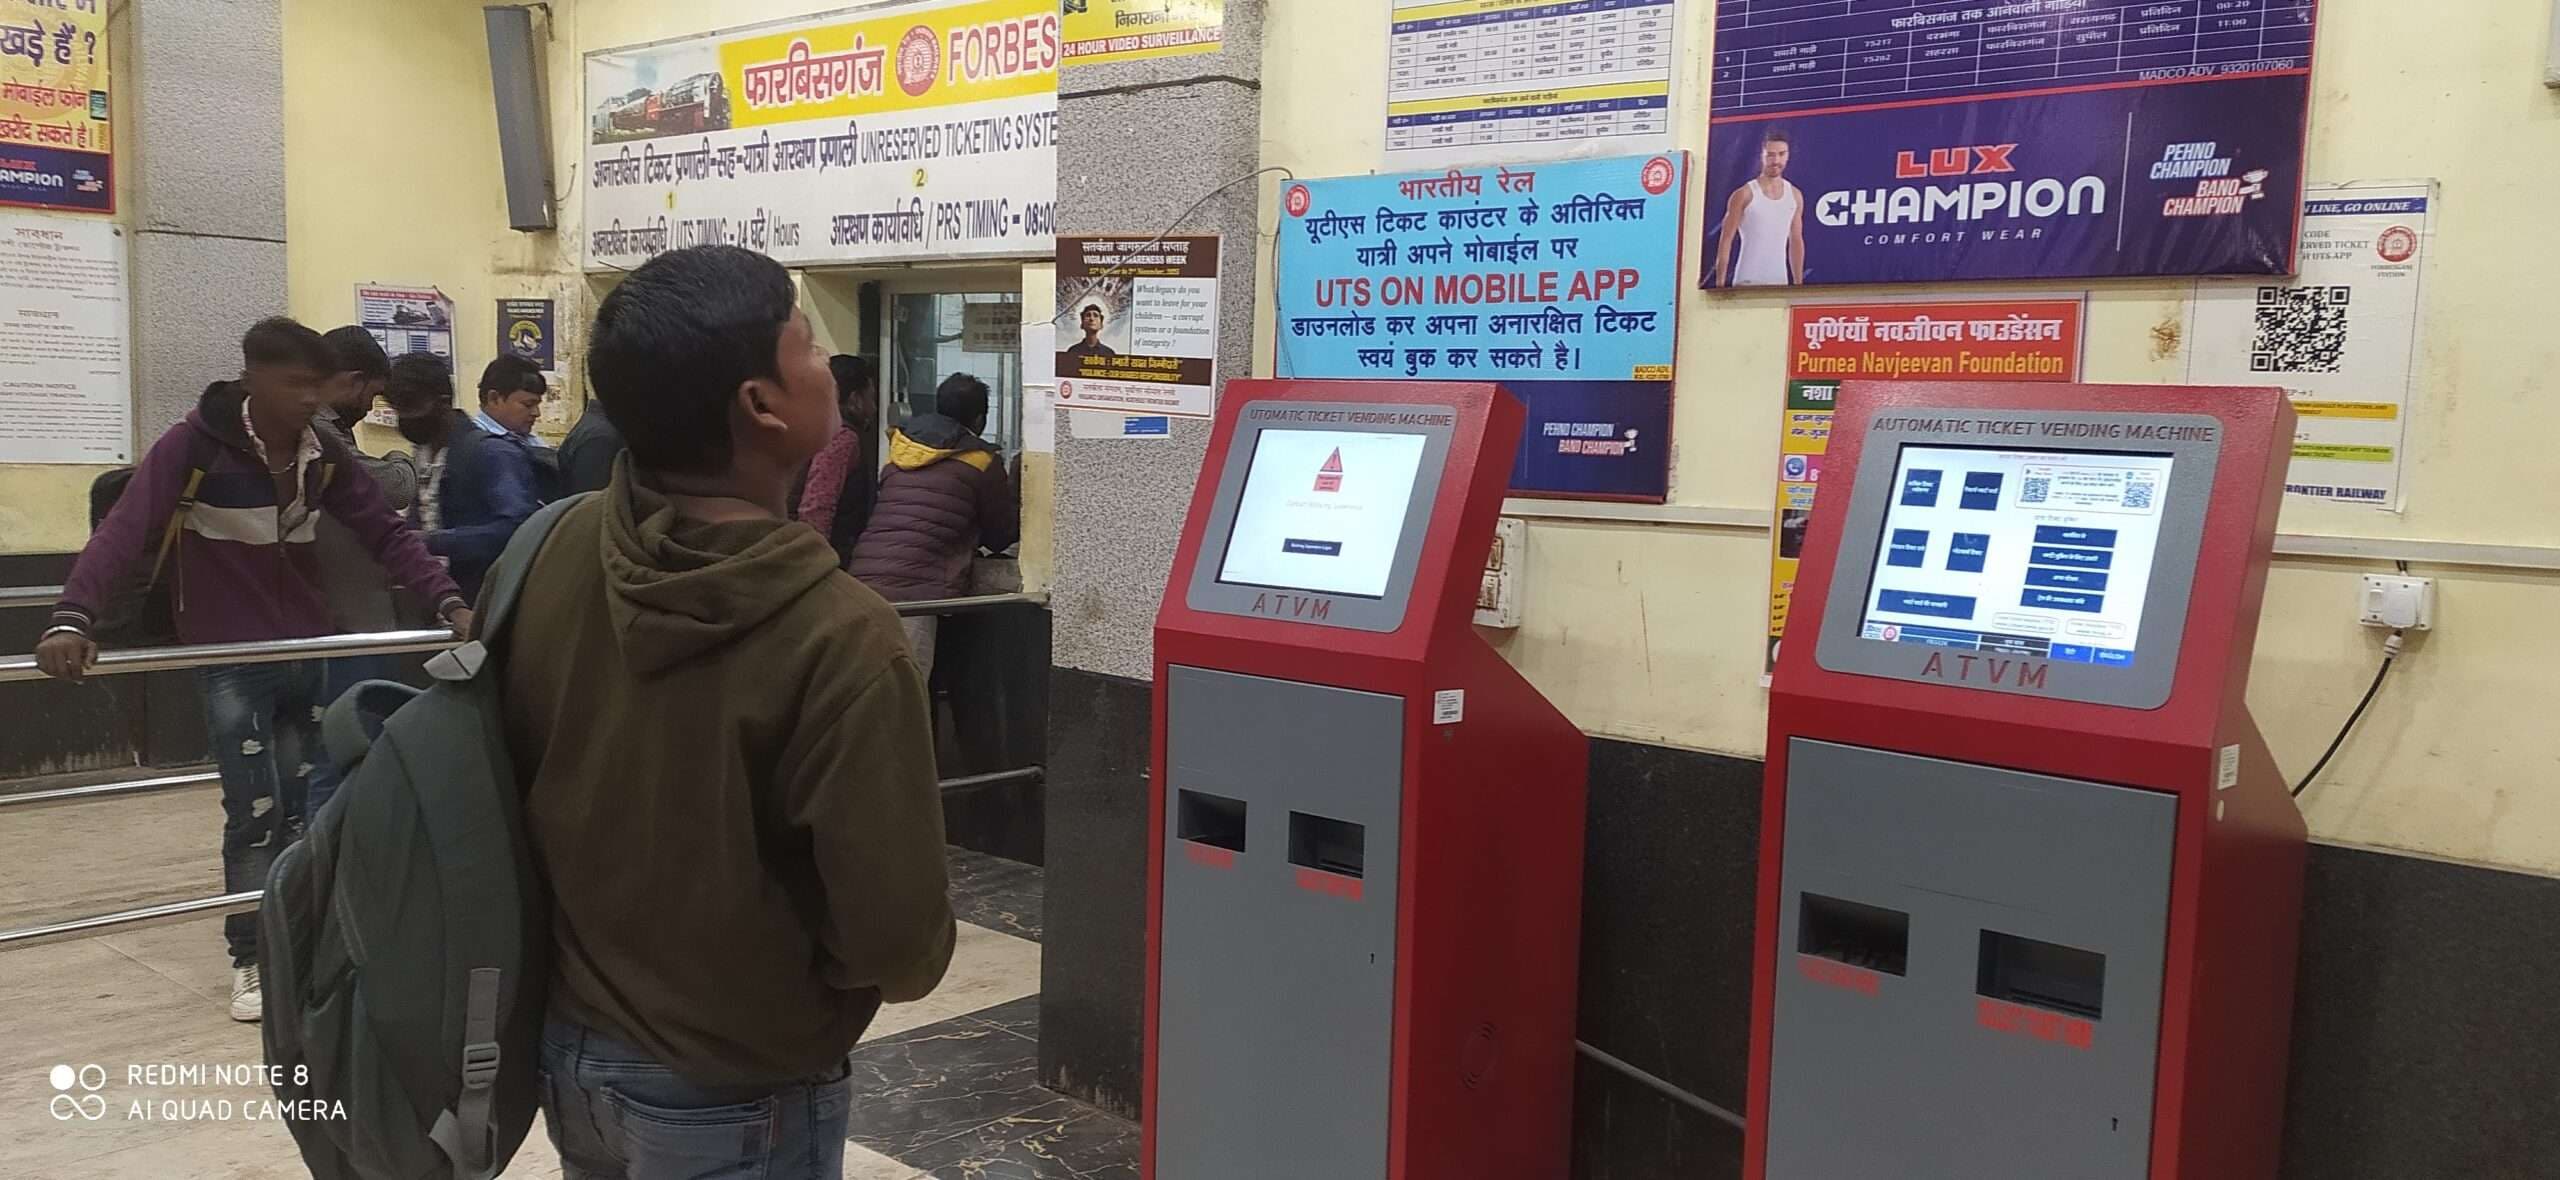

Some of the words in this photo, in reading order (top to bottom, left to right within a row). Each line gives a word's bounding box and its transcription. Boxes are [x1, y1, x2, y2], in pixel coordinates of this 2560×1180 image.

[1961, 9, 1984, 20] तक
[2140, 6, 2182, 18] प्रतिदिन
[2139, 23, 2181, 35] प्रतिदिन
[52, 22, 77, 65] हैं
[84, 31, 96, 65] ?
[949, 15, 1058, 82] FORBES
[1063, 43, 1076, 57] 24
[1077, 40, 1107, 55] HOUR
[1108, 36, 1140, 51] VIDEO
[1141, 28, 1221, 49] SURVEILLANCE
[744, 36, 885, 106] फारबिसगंज
[59, 84, 88, 111] फोन
[36, 120, 73, 145] सकते
[861, 124, 941, 164] UNRESERVED
[944, 116, 1011, 157] TICKETING
[592, 145, 641, 189] अनारक्षित
[643, 143, 674, 184] टिकट
[772, 138, 816, 173] आरक्षण
[819, 120, 858, 175] प्रणाली
[1895, 143, 2022, 180] LUX
[2163, 141, 2217, 162] PEHNO
[915, 168, 926, 188] 2
[2149, 157, 2231, 181] CHAMPION
[1399, 169, 1483, 200] भारतीय
[1498, 167, 1536, 194] रेल
[2196, 178, 2240, 198] BANO
[1815, 175, 2106, 227] CHAMPION
[2162, 194, 2246, 217] CHAMPION
[2310, 203, 2342, 213] LINE,
[2343, 202, 2363, 212] GO
[2363, 201, 2411, 211] ONLINE
[830, 214, 869, 246] आरक्षण
[935, 202, 961, 241] PRS
[965, 197, 1008, 239] TIMING
[1306, 209, 1366, 243] यूटीएस
[1376, 206, 1428, 234] टिकट
[1439, 200, 1508, 230] काउंटर
[1519, 198, 1539, 226] के
[1550, 191, 1647, 225] अतिरिक्त
[773, 215, 800, 247] Hours
[1863, 229, 1967, 246] COMFORT
[1981, 226, 2044, 242] WEAR
[2304, 230, 2331, 238] CODE
[1161, 241, 1191, 254] सप्ताह
[1357, 238, 1398, 268] यात्री
[1408, 235, 1453, 266] अपने
[1464, 233, 1539, 265] मोबाईल
[1551, 236, 1580, 259] पर
[2335, 240, 2370, 249] TICKET
[1082, 255, 1122, 265] VIGILANCE
[1122, 255, 1165, 265] AWARENESS
[1166, 255, 1188, 265] WEEK
[1136, 284, 1154, 293] What
[1178, 285, 1187, 294] do
[1187, 287, 1201, 296] you
[1315, 277, 1371, 308] UTS
[1380, 275, 1424, 305] ON
[1434, 270, 1559, 305] MOBILE
[1567, 268, 1641, 301] APP
[1135, 311, 1162, 320] children
[1162, 299, 1179, 307] leave
[1180, 300, 1190, 310] for
[1191, 301, 1208, 310] your
[1135, 326, 1157, 335] system
[1173, 326, 1210, 337] foundation
[1291, 309, 1376, 338] डाउनलोड
[1386, 314, 1414, 338] कर
[1425, 312, 1478, 337] अपना
[1488, 306, 1583, 336] अनारक्षित
[1595, 304, 1658, 334] टिकट
[1804, 316, 1870, 349] पूर्णियाँ
[1873, 315, 1964, 342] नवजीवन
[1142, 339, 1171, 350] integrity
[1358, 342, 1395, 370] स्वयं
[1404, 346, 1437, 378] बुक
[1447, 346, 1478, 369] कर
[1490, 341, 1543, 371] सकते
[1798, 352, 1856, 374] Purnea
[1862, 351, 1953, 379] Navjeevan
[1959, 350, 2064, 374] Foundation
[1307, 410, 1345, 424] TICKET
[1347, 411, 1397, 425] VENDING
[1399, 413, 1453, 427] MACHINE
[1543, 422, 1570, 437] PEHNO
[1571, 423, 1616, 437] CHAMPION
[1873, 417, 1972, 435] AUTOMATIC
[1978, 419, 2037, 437] TICKET
[2040, 421, 2122, 439] VENDING
[2125, 424, 2215, 442] MACHINE
[1558, 439, 1581, 453] BANO
[1581, 440, 1626, 456] CHAMPION
[2336, 486, 2387, 500] RAILWAY
